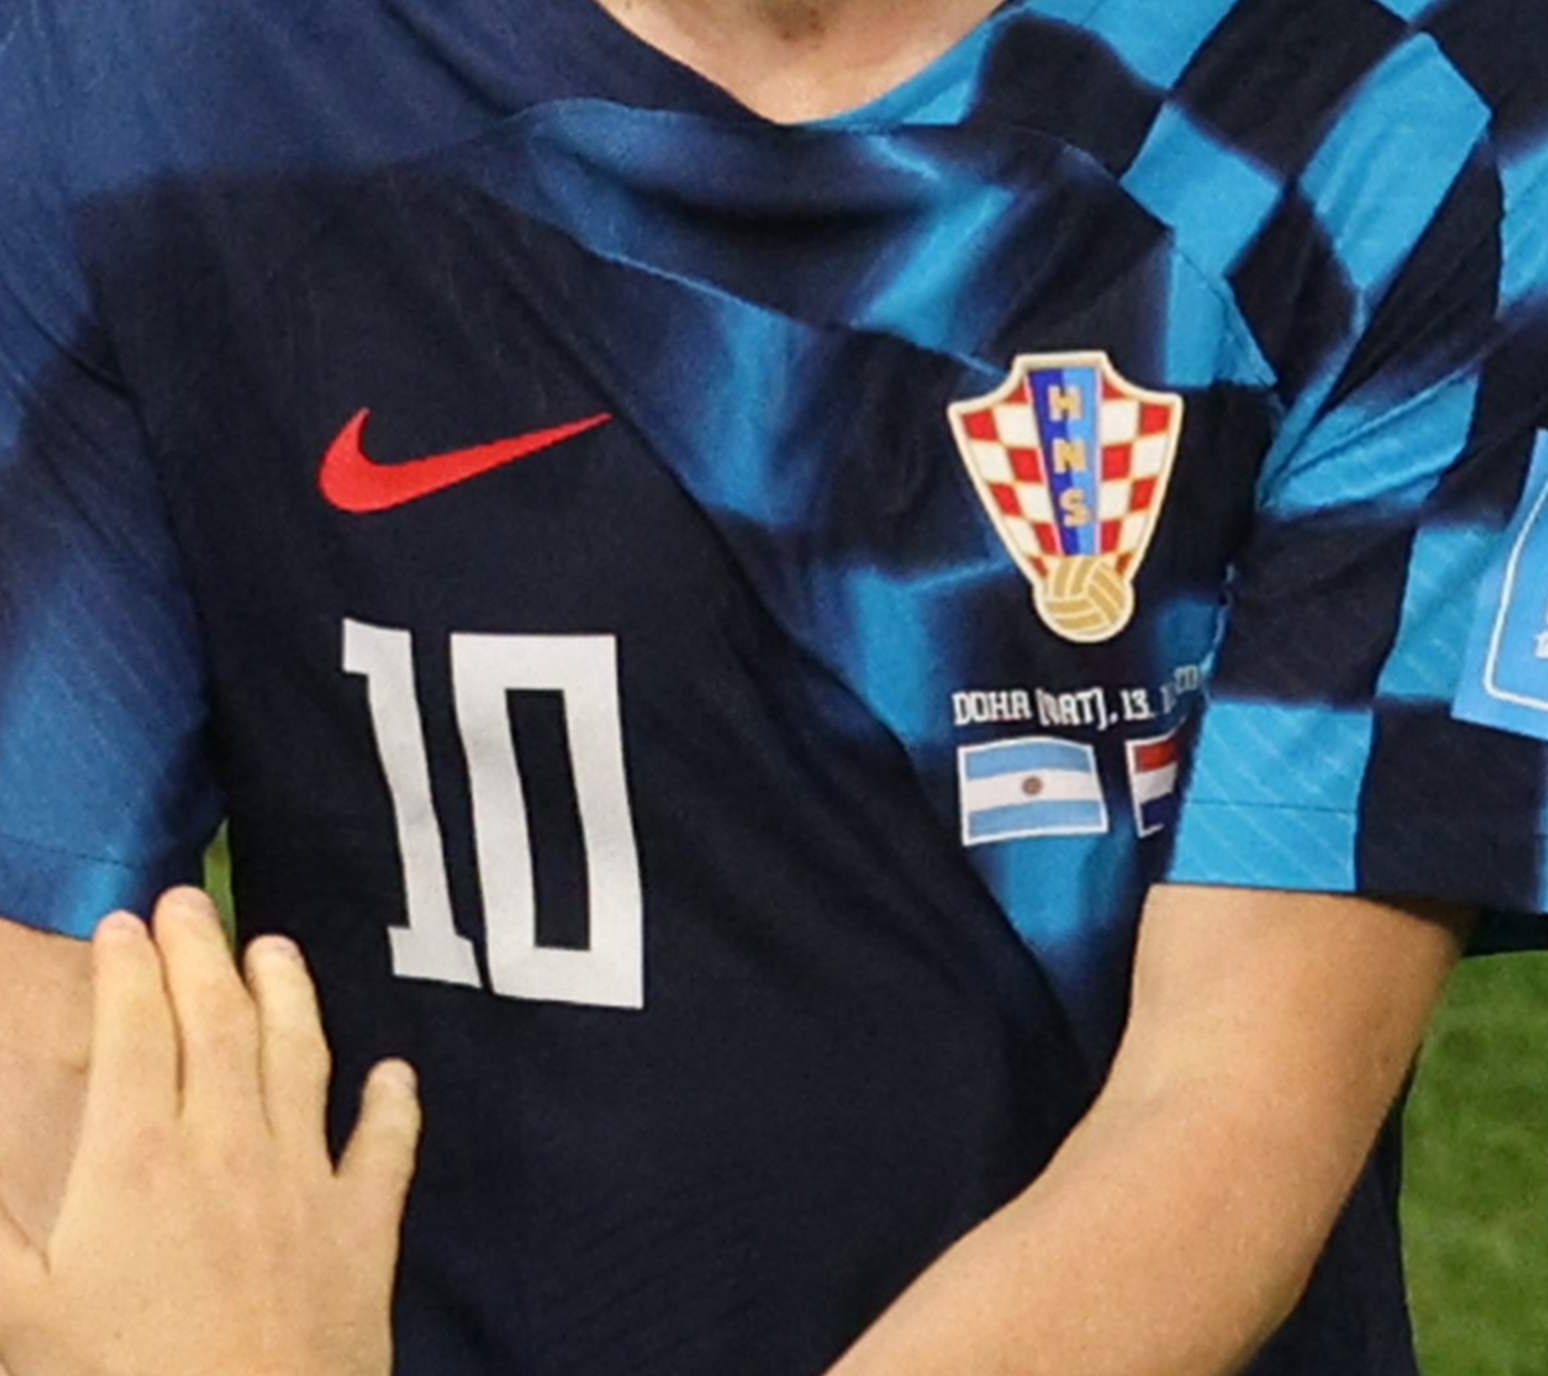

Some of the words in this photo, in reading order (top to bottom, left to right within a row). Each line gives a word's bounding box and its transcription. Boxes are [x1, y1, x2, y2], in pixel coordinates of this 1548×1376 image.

[1047, 385, 1089, 526] HNS
[952, 689, 1033, 726] DOHA
[341, 617, 644, 1010] 10
